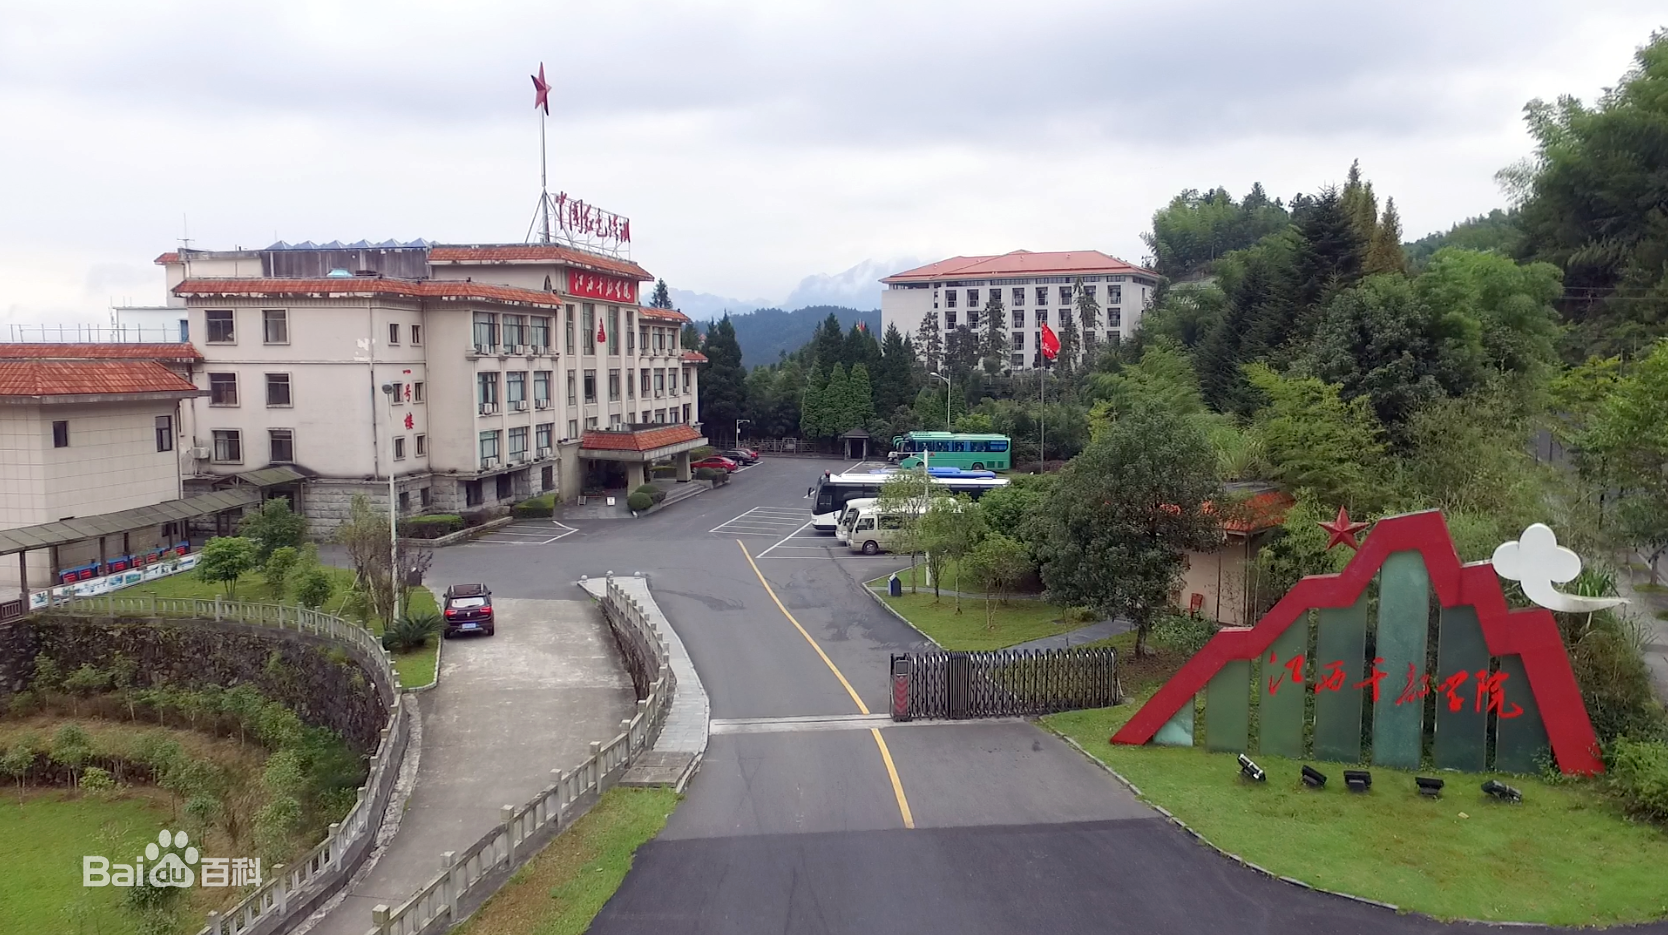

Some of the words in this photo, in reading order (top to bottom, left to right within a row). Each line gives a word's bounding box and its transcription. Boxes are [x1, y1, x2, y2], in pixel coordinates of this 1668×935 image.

[402, 369, 414, 430] 一号楼
[1268, 651, 1524, 718] 江西干部学院
